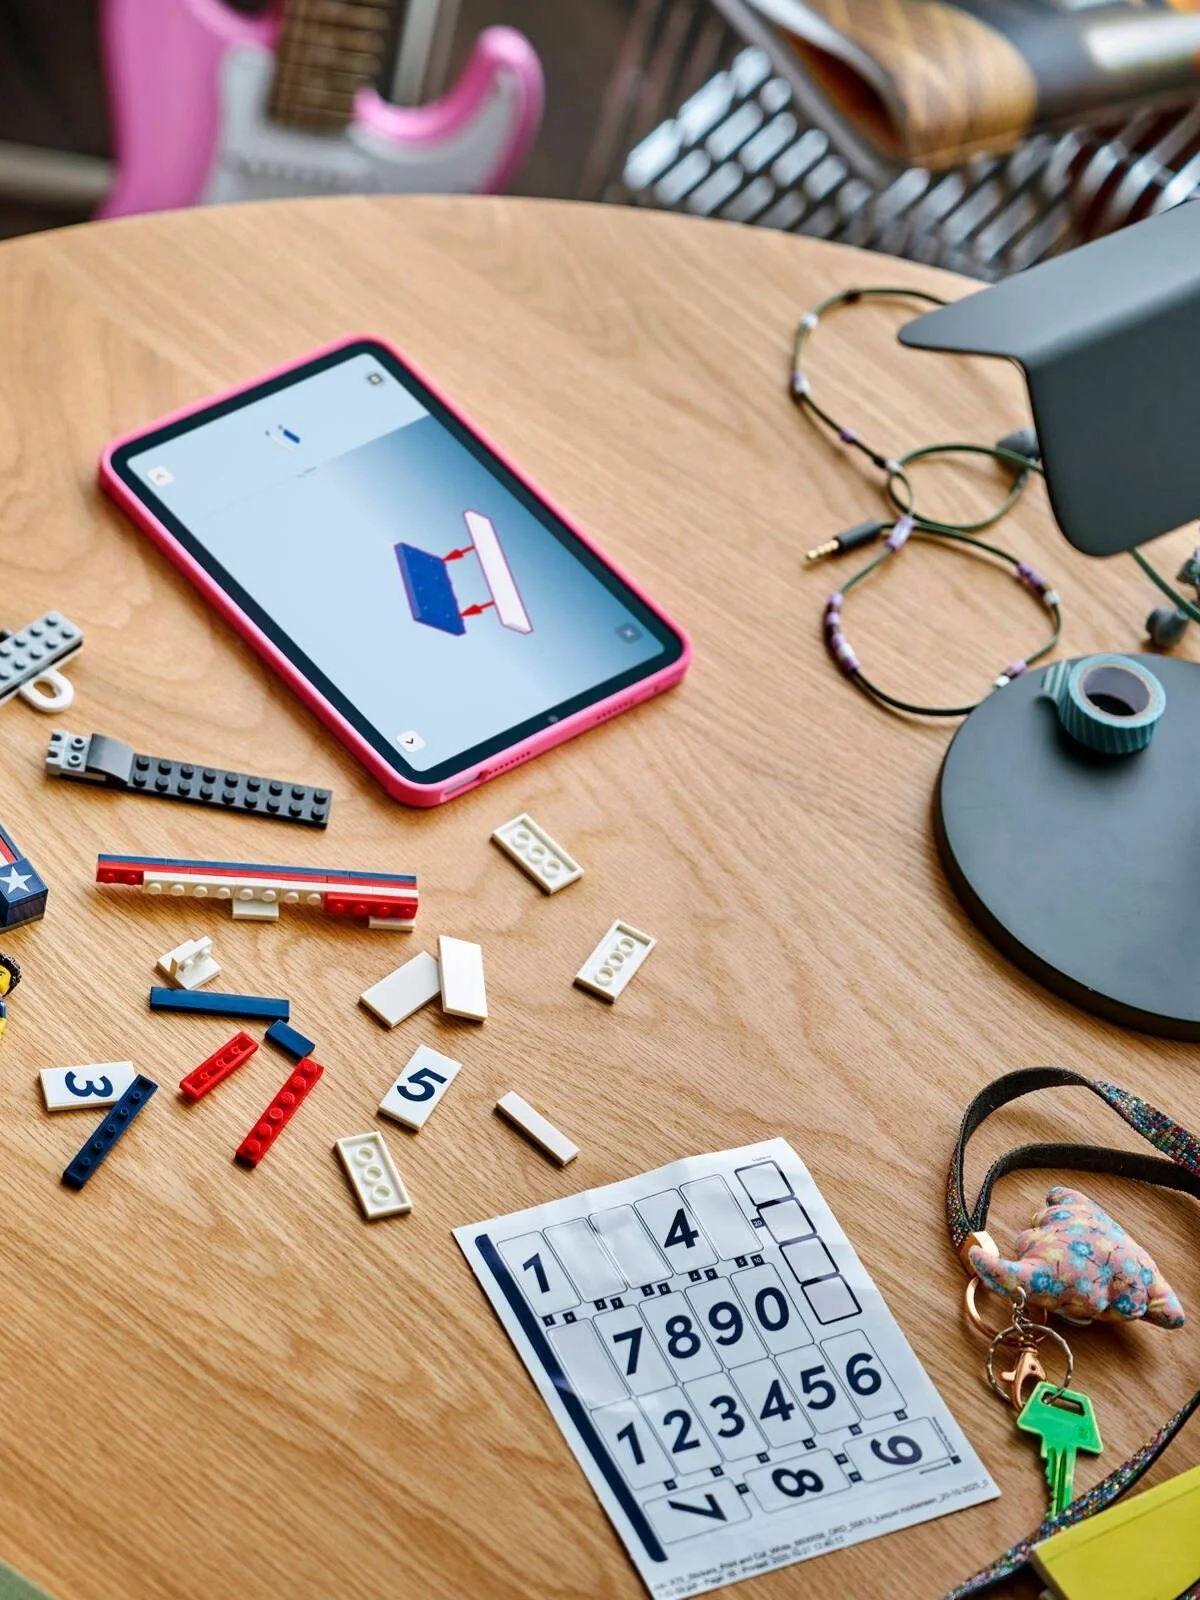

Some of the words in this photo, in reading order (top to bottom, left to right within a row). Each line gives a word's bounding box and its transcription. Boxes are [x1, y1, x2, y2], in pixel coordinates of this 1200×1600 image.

[64, 1071, 114, 1098] 3
[396, 1067, 448, 1102] 5
[522, 1252, 551, 1294] 1
[663, 1207, 700, 1249] 4
[612, 1326, 643, 1376] 7
[665, 1314, 701, 1359] 8
[708, 1301, 744, 1346] 9
[754, 1286, 790, 1332] 0
[616, 1421, 646, 1465] 1
[663, 1409, 701, 1454] 2
[709, 1395, 745, 1438] 3
[759, 1379, 795, 1422] 4
[800, 1364, 837, 1410] 5
[845, 1352, 882, 1396] 6
[667, 1493, 727, 1522] 7
[771, 1468, 824, 1498] 8
